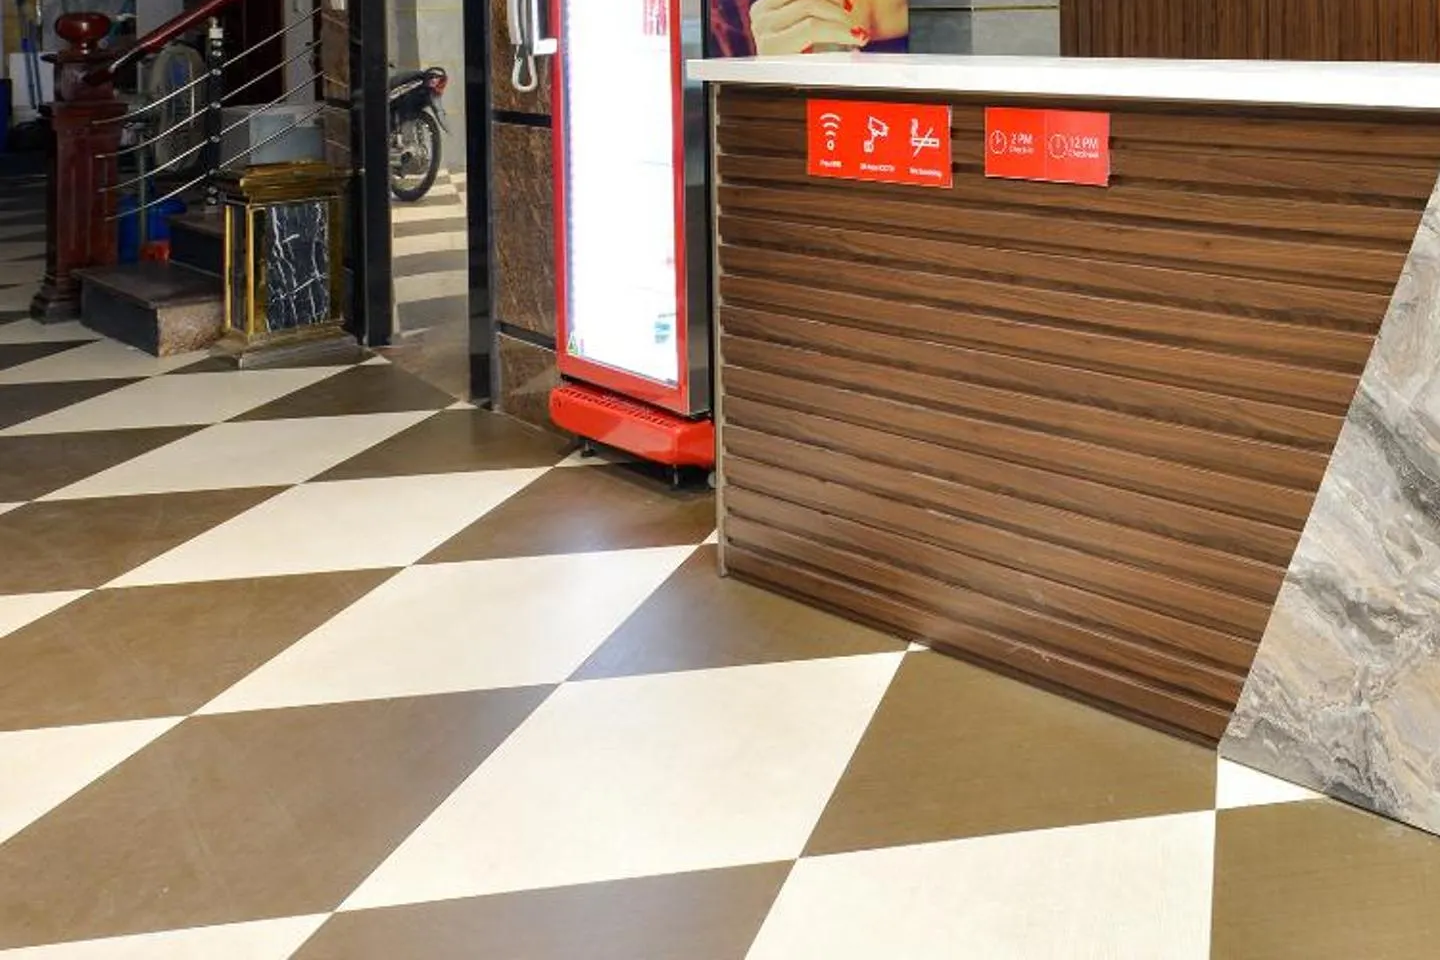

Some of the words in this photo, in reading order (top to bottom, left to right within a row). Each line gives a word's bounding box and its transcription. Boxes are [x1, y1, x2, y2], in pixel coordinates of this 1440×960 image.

[1018, 133, 1033, 145] PM
[1070, 135, 1081, 149] 12
[1082, 136, 1098, 149] PM
